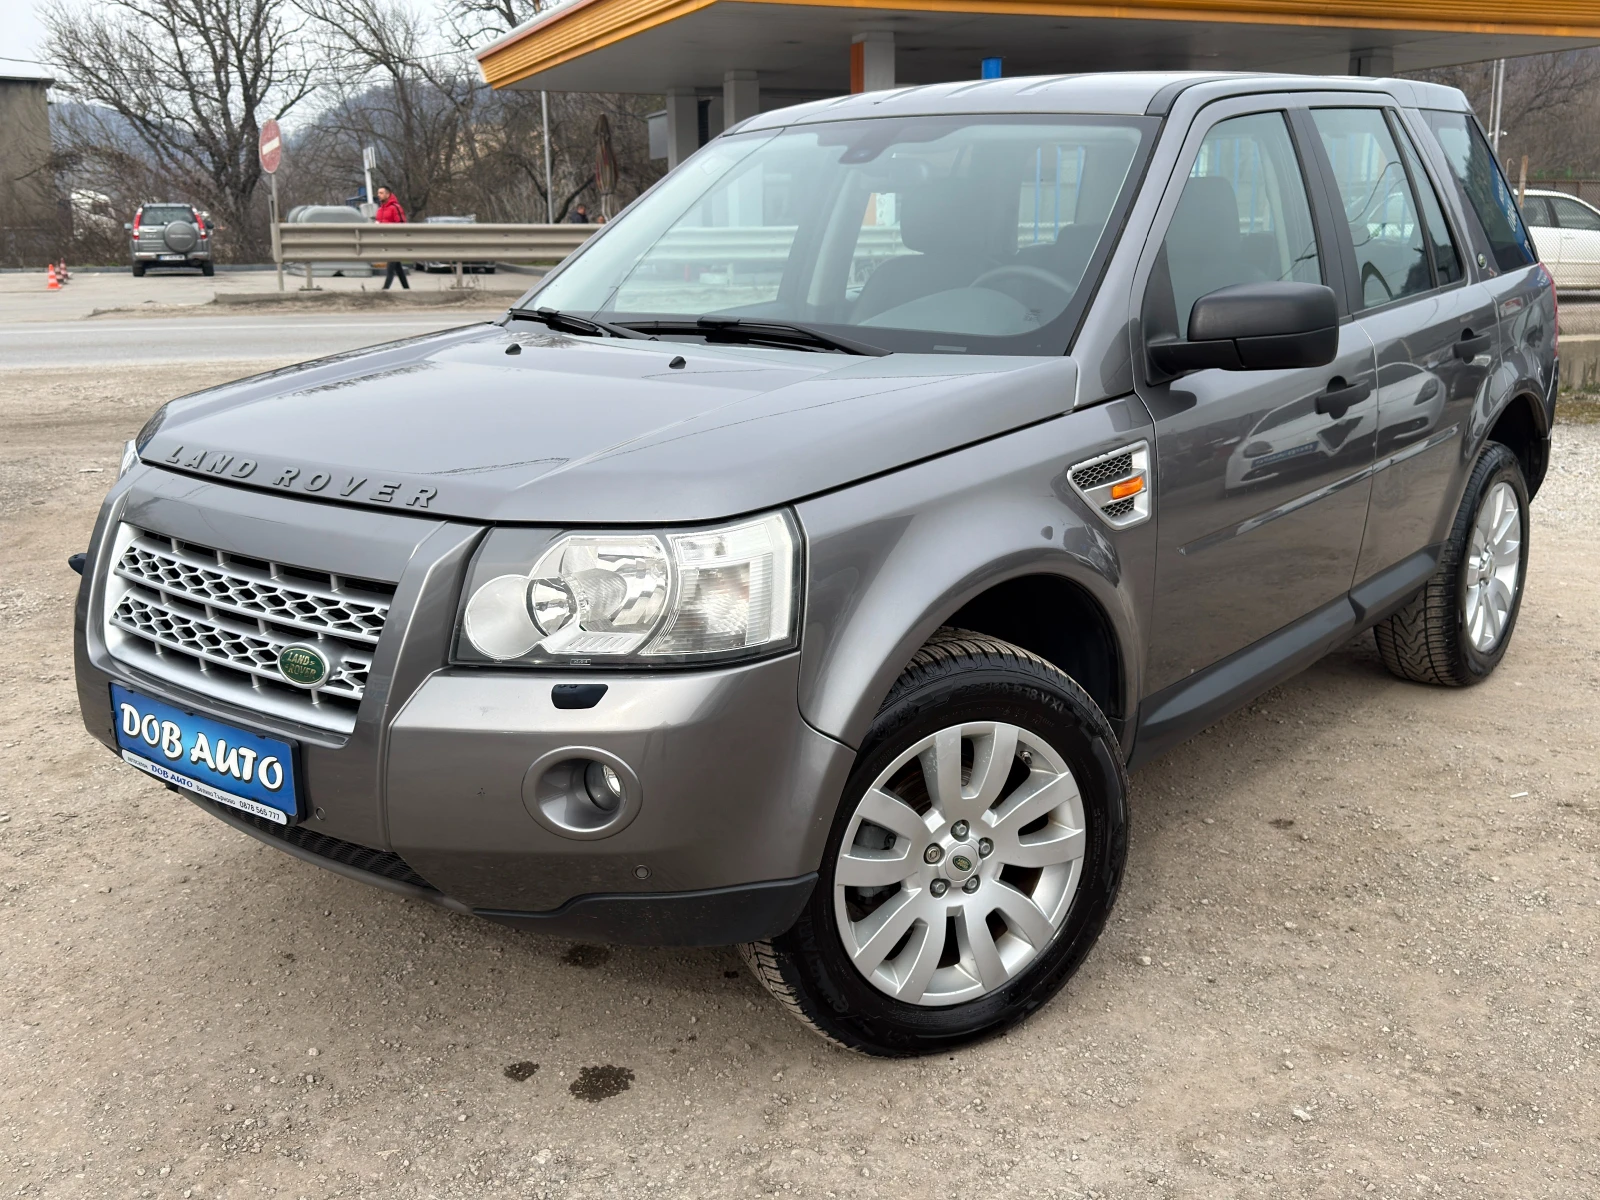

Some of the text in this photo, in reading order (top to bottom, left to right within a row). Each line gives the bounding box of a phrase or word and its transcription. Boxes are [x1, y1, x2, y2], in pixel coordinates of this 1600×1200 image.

[165, 444, 438, 508] LAND ROVER
[287, 652, 311, 666] LAND
[287, 664, 317, 679] ROVER
[120, 703, 283, 790] DOB AUTO
[151, 764, 169, 779] DOB
[170, 774, 193, 788] AUTO
[239, 801, 255, 812] 0878
[255, 806, 268, 816] 565
[268, 810, 280, 821] 777
